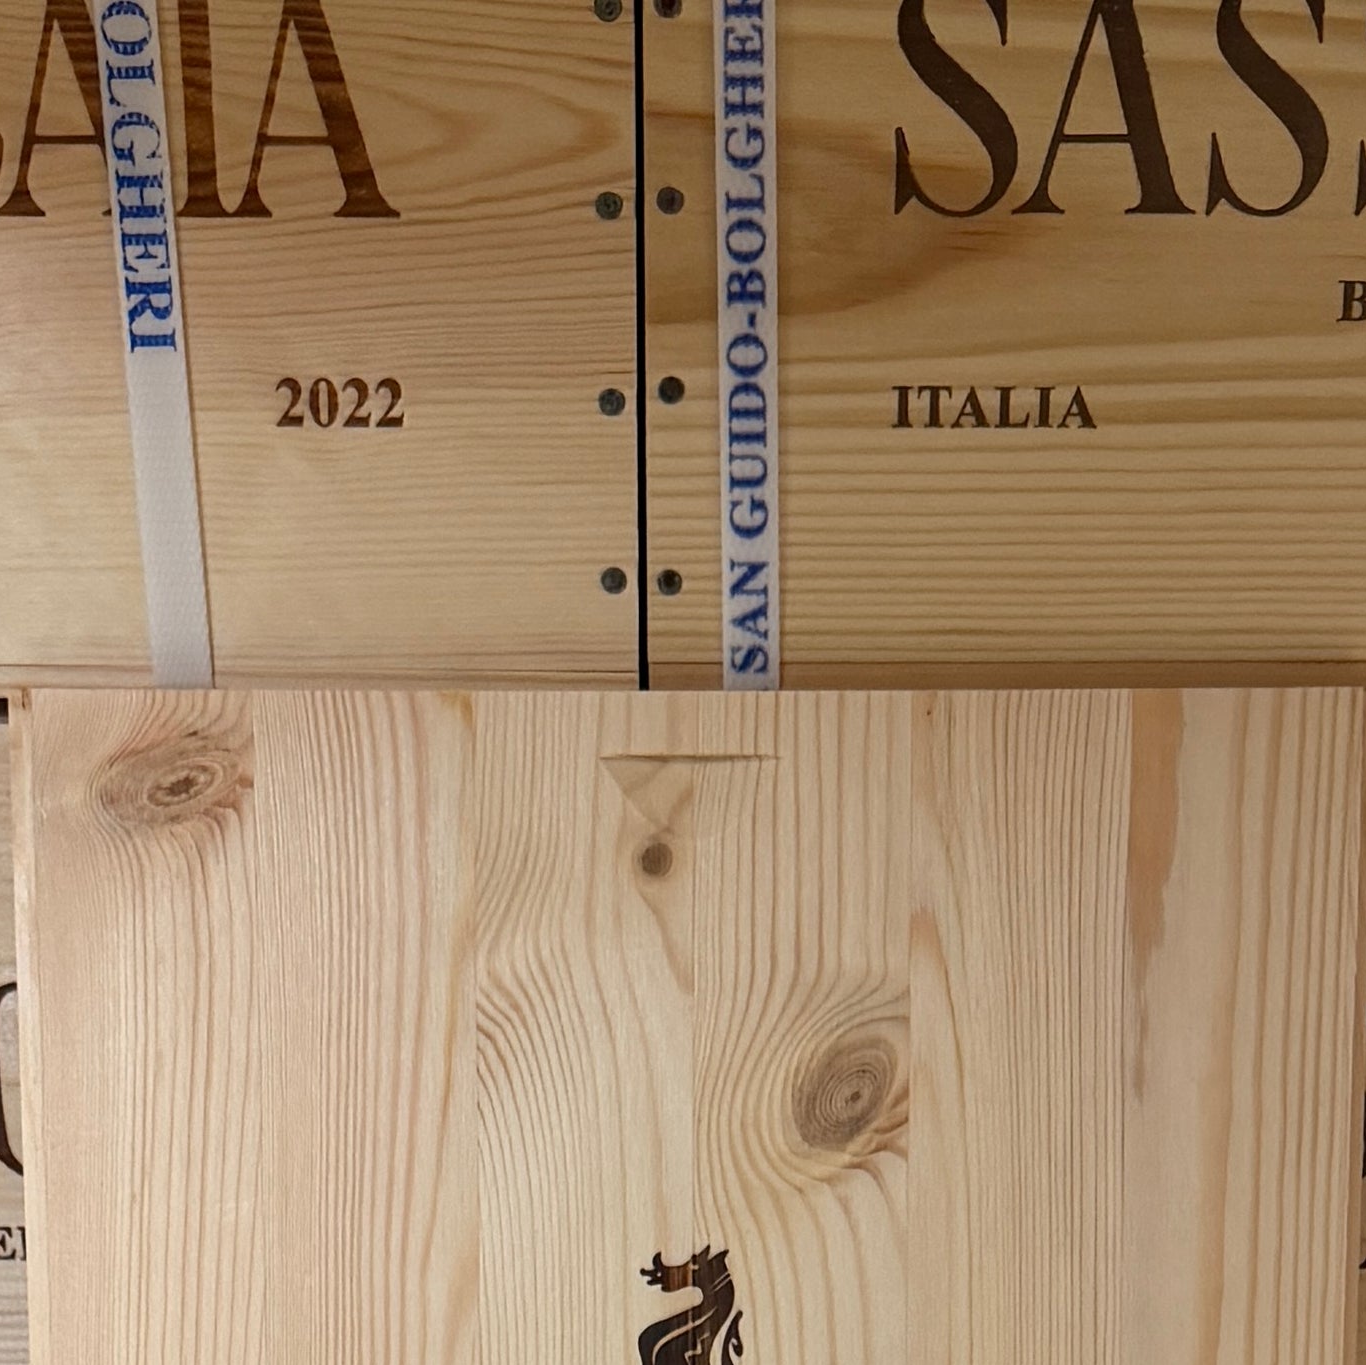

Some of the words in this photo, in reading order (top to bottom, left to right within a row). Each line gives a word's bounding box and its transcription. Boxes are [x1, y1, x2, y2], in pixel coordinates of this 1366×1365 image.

[275, 377, 406, 430] 2022
[891, 385, 1099, 431] ITALIA
[730, 558, 771, 675] SAN
